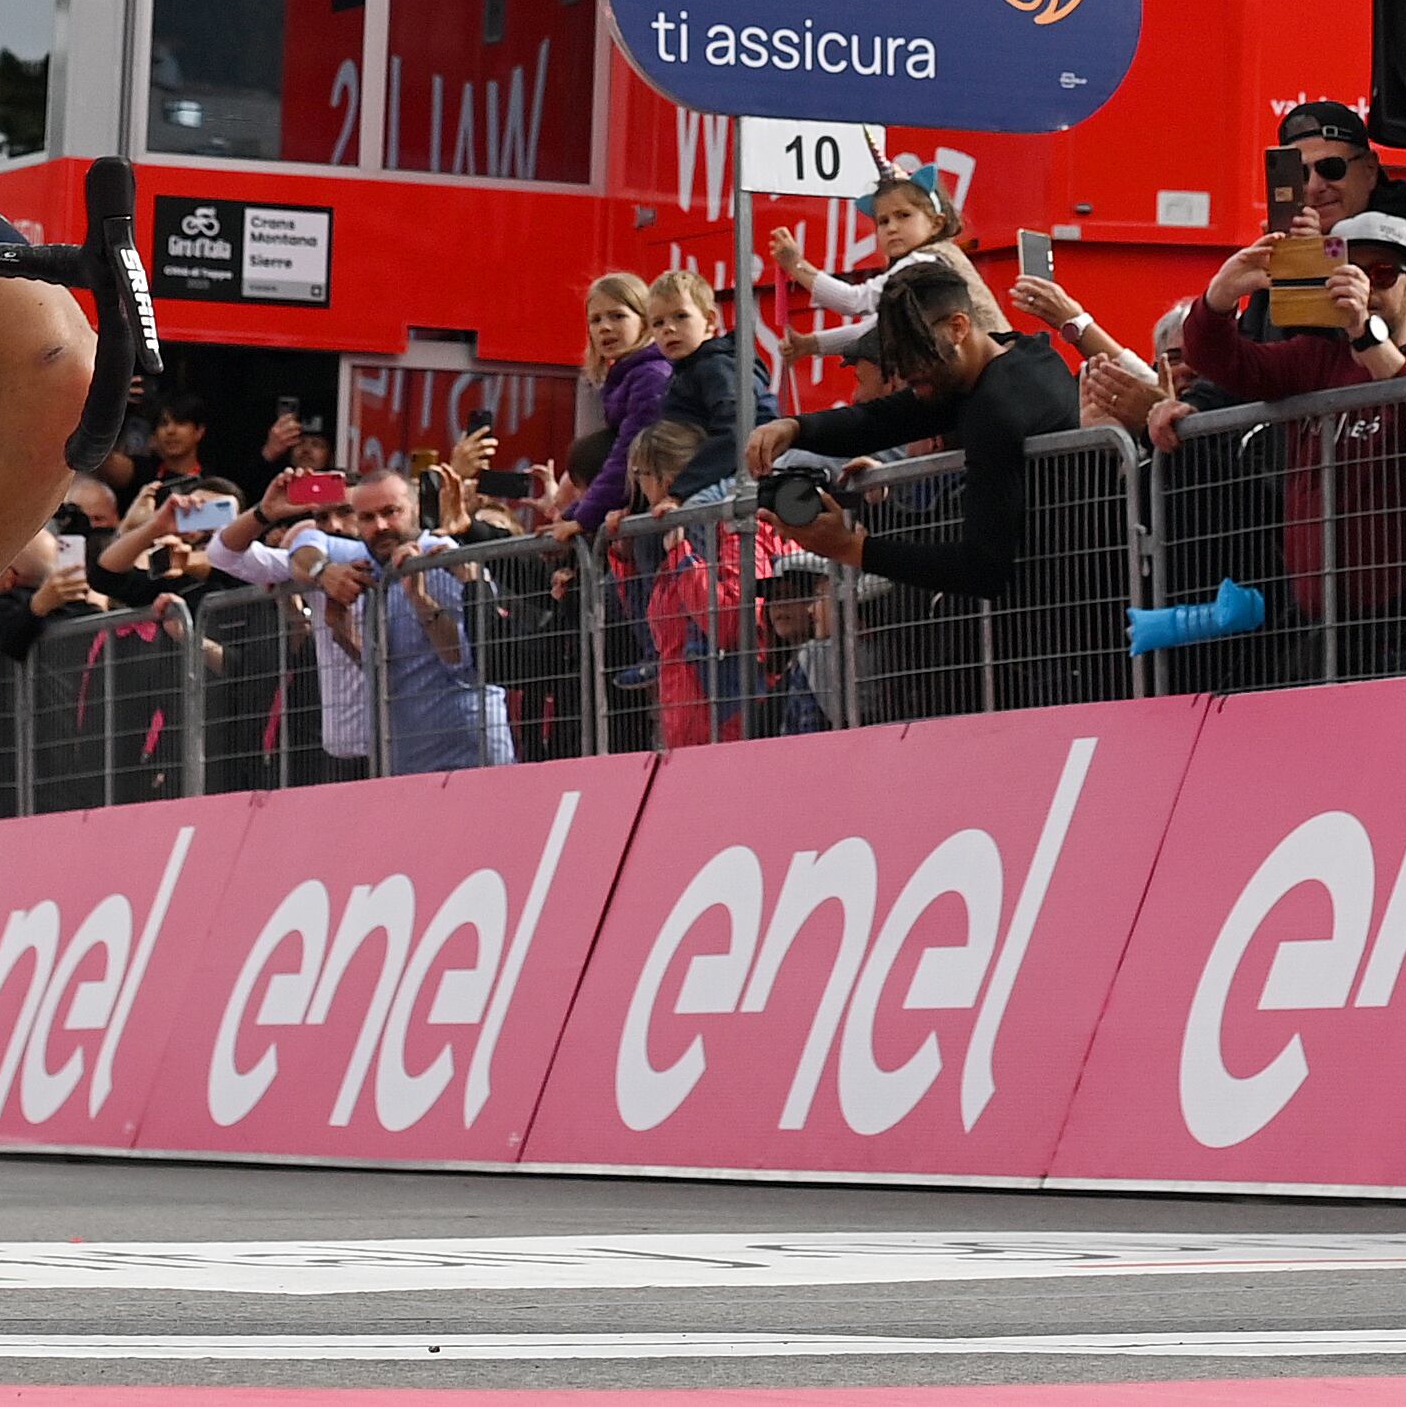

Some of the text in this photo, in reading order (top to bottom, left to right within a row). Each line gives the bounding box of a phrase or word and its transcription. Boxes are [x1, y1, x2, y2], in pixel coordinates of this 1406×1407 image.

[651, 11, 937, 80] ti assicura
[784, 135, 841, 182] 10
[249, 254, 293, 268] Sierre
[250, 232, 318, 247] Montana
[120, 248, 160, 353] SRAM
[207, 791, 581, 1131] enel
[615, 736, 1097, 1135] enel
